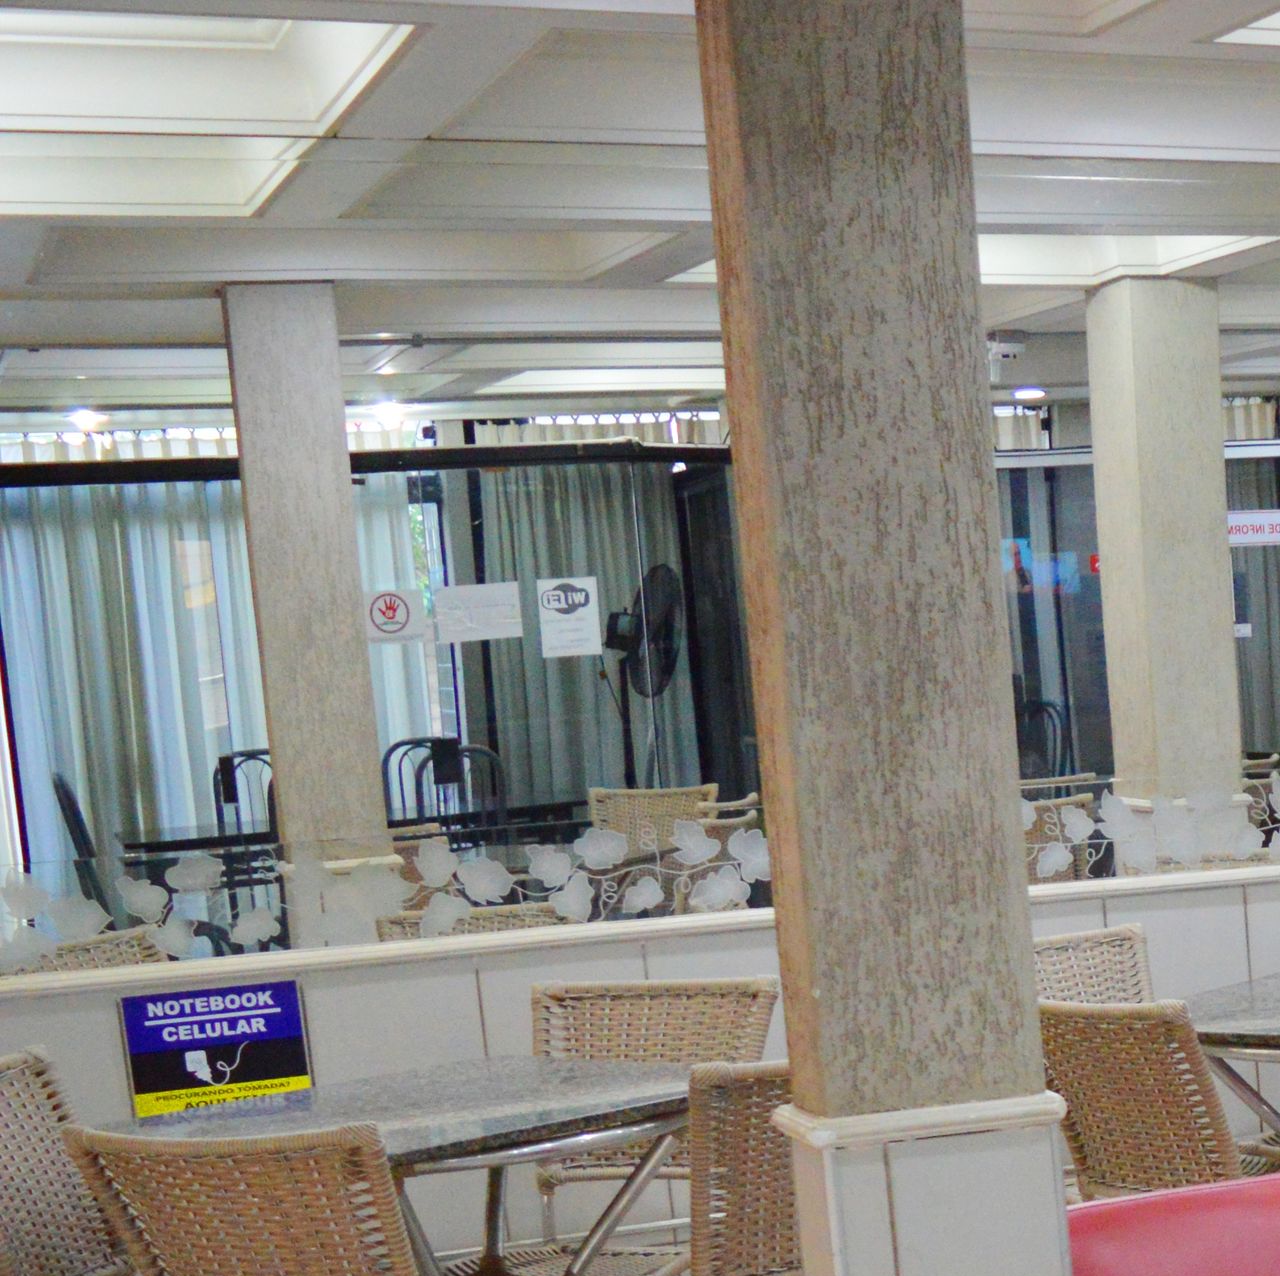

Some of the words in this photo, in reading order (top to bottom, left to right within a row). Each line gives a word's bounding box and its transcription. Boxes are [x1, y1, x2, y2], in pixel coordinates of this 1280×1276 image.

[146, 990, 275, 1018] NOTEBOOK
[161, 1017, 267, 1042] CELULAR
[155, 1087, 234, 1103] PROCURANDO
[237, 1081, 291, 1093] TOMADA?
